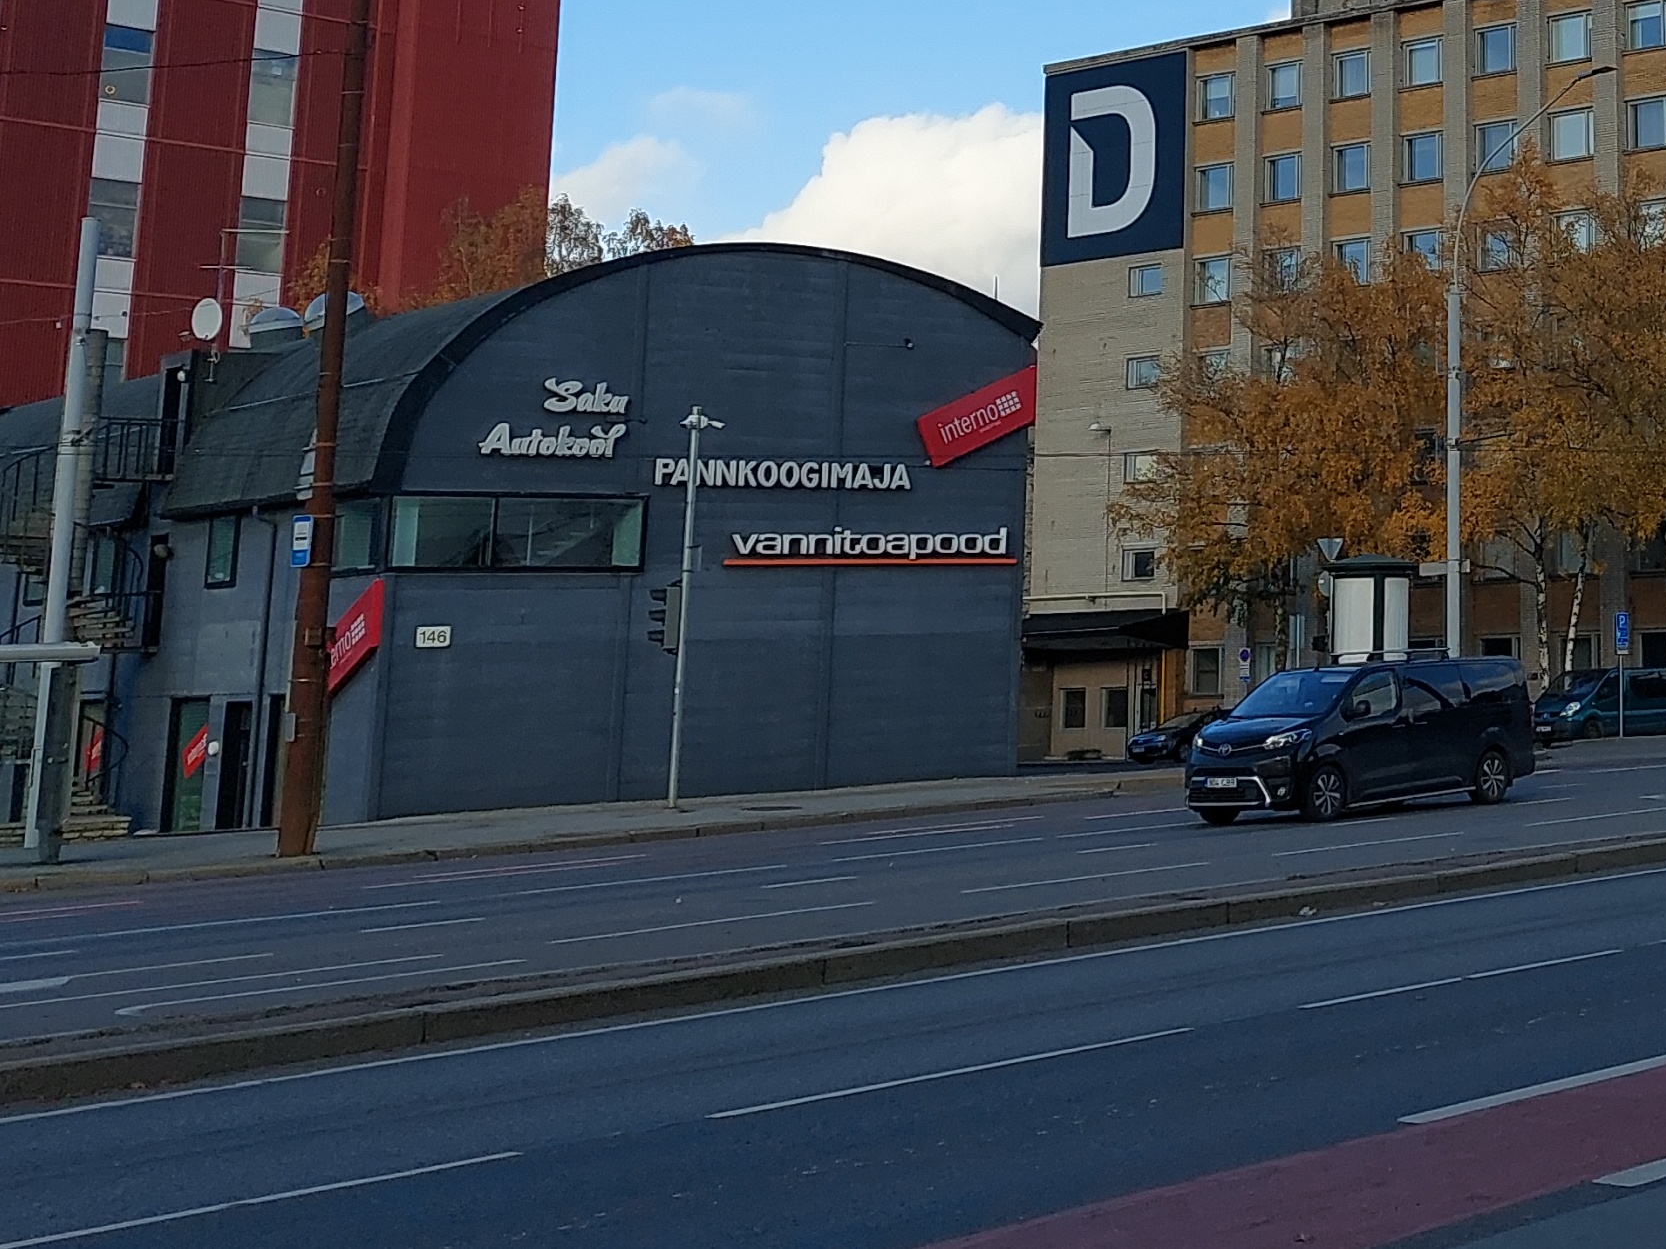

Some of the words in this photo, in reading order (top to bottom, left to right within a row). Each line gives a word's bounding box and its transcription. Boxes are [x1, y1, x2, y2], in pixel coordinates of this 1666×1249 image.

[1067, 84, 1156, 239] D
[543, 377, 630, 414] Saku
[477, 422, 627, 458] Autokool
[937, 403, 999, 445] interno
[654, 457, 912, 490] PANNKOOGIMAJA
[732, 526, 1009, 560] vannitoapood
[418, 630, 447, 644] 146
[1618, 615, 1626, 629] P
[330, 630, 351, 670] erno
